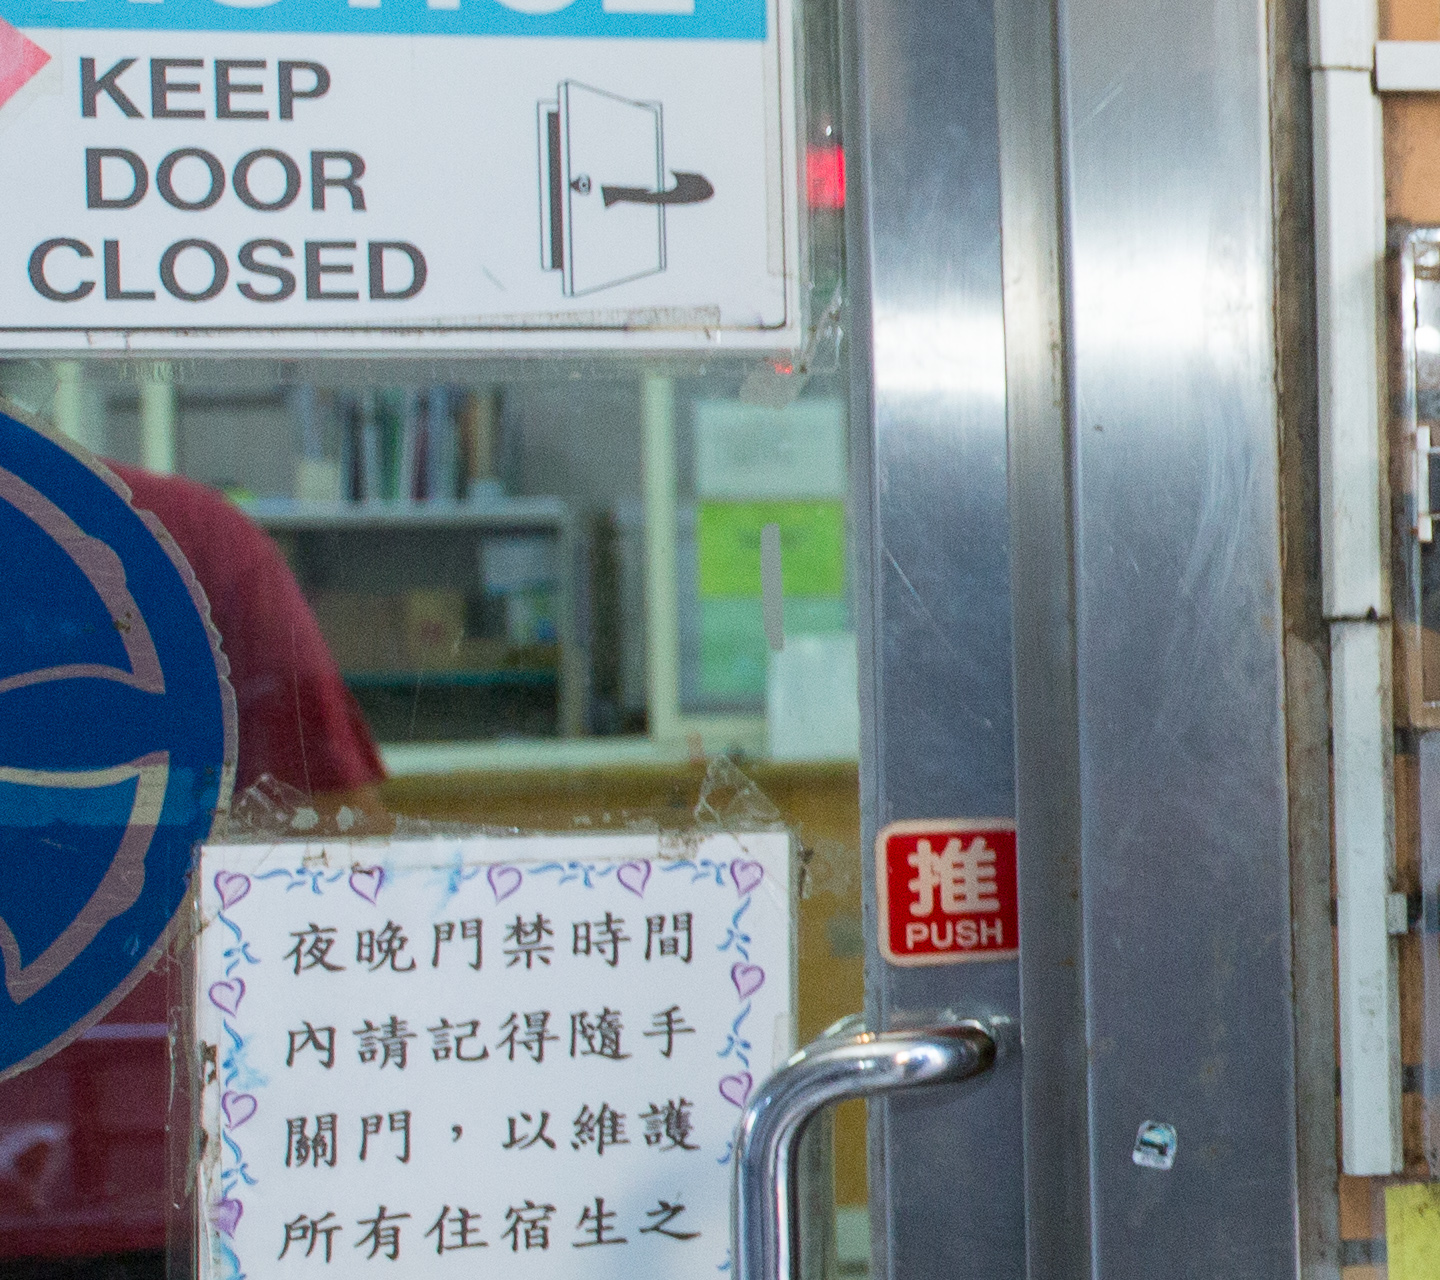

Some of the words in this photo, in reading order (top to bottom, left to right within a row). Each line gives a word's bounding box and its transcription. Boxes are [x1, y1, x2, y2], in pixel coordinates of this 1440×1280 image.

[79, 56, 333, 122] KEEP
[85, 147, 367, 212] DOOR
[27, 237, 428, 303] CLOSED
[907, 836, 1000, 917] 推
[283, 911, 697, 976] 夜晚門禁時間
[906, 918, 1003, 950] PUSH
[284, 1003, 699, 1072] 內請記得隨手
[283, 1097, 701, 1170] 關門，以維護
[276, 1196, 703, 1265] 所有住宿生之
